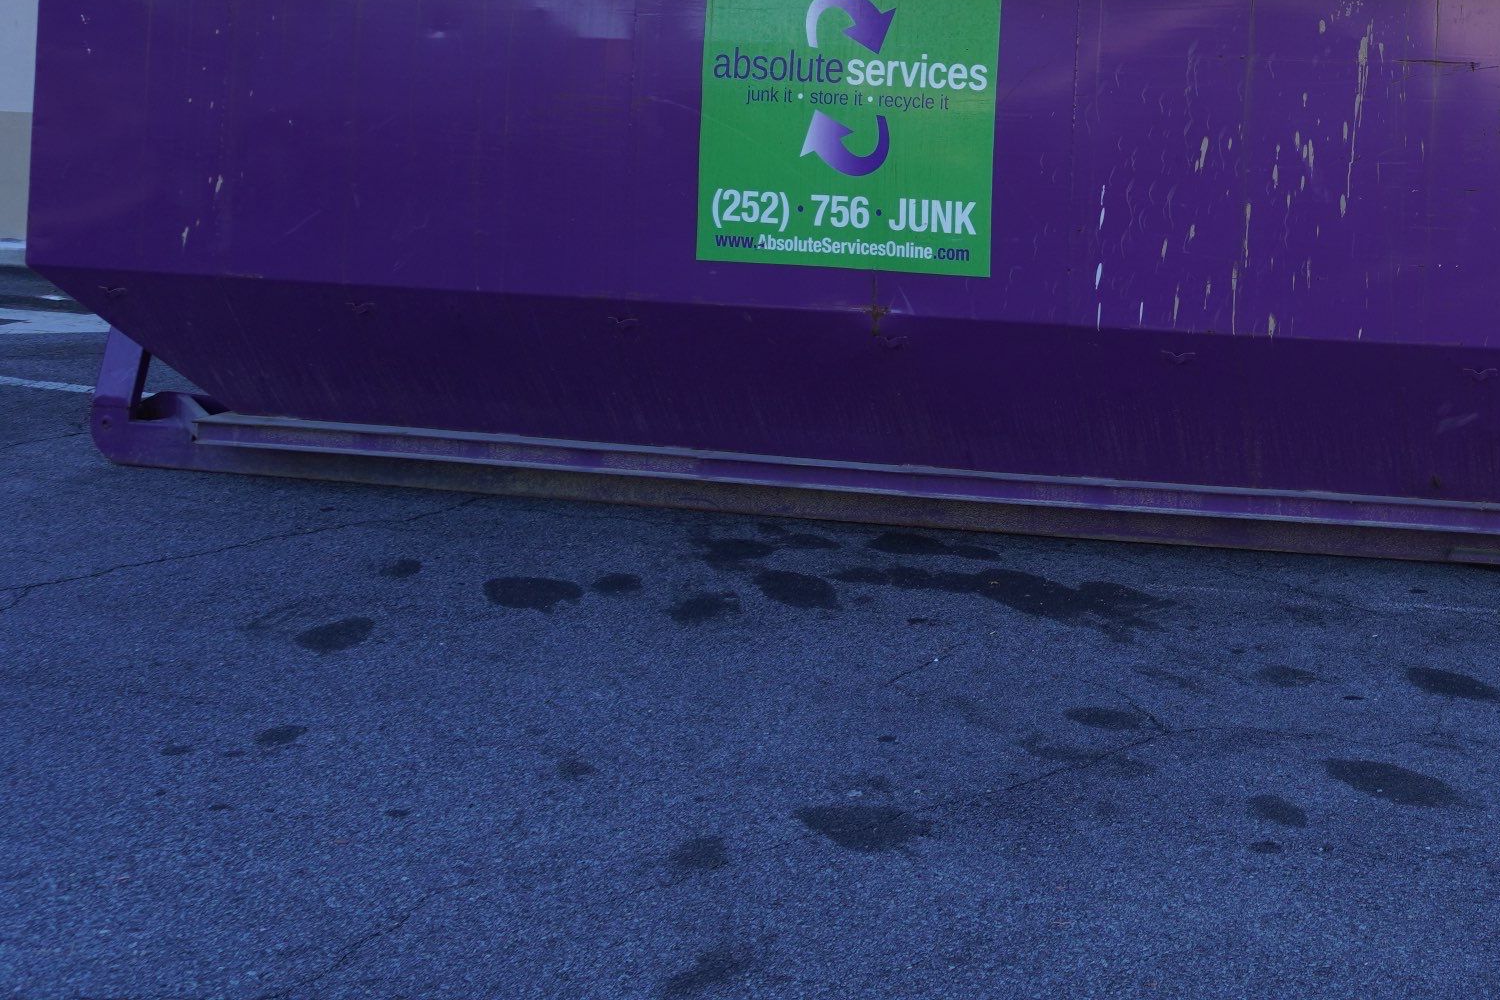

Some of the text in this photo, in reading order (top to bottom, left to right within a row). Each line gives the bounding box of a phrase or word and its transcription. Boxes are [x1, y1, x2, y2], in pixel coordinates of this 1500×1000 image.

[746, 85, 950, 111] junk it store it recycle it
[712, 188, 977, 235] (252) 756 JUNK
[715, 234, 970, 262] www.AbsoluteServicesOnline.com
